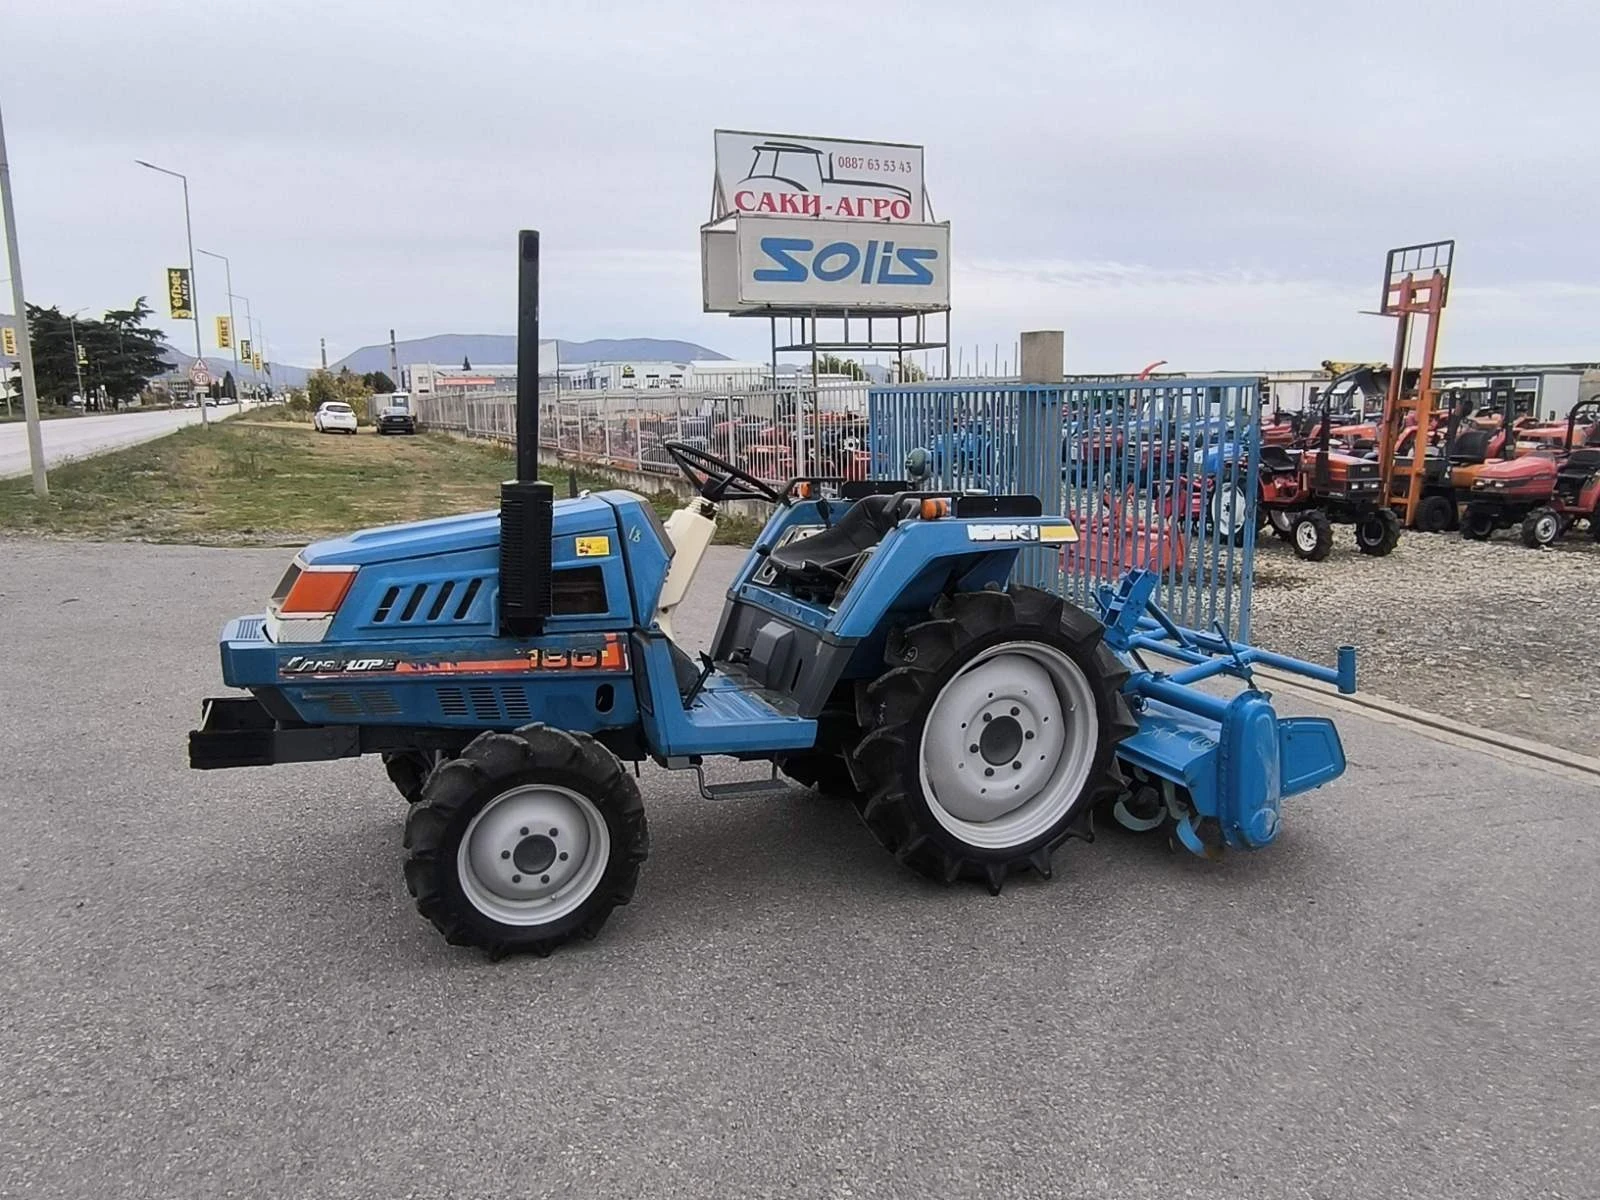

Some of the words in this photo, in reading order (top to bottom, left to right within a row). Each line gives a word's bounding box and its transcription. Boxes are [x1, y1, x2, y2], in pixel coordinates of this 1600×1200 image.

[838, 156, 865, 170] 0887
[867, 158, 881, 171] 63
[883, 160, 897, 173] 53
[899, 161, 912, 174] 43
[170, 271, 183, 307] efbet
